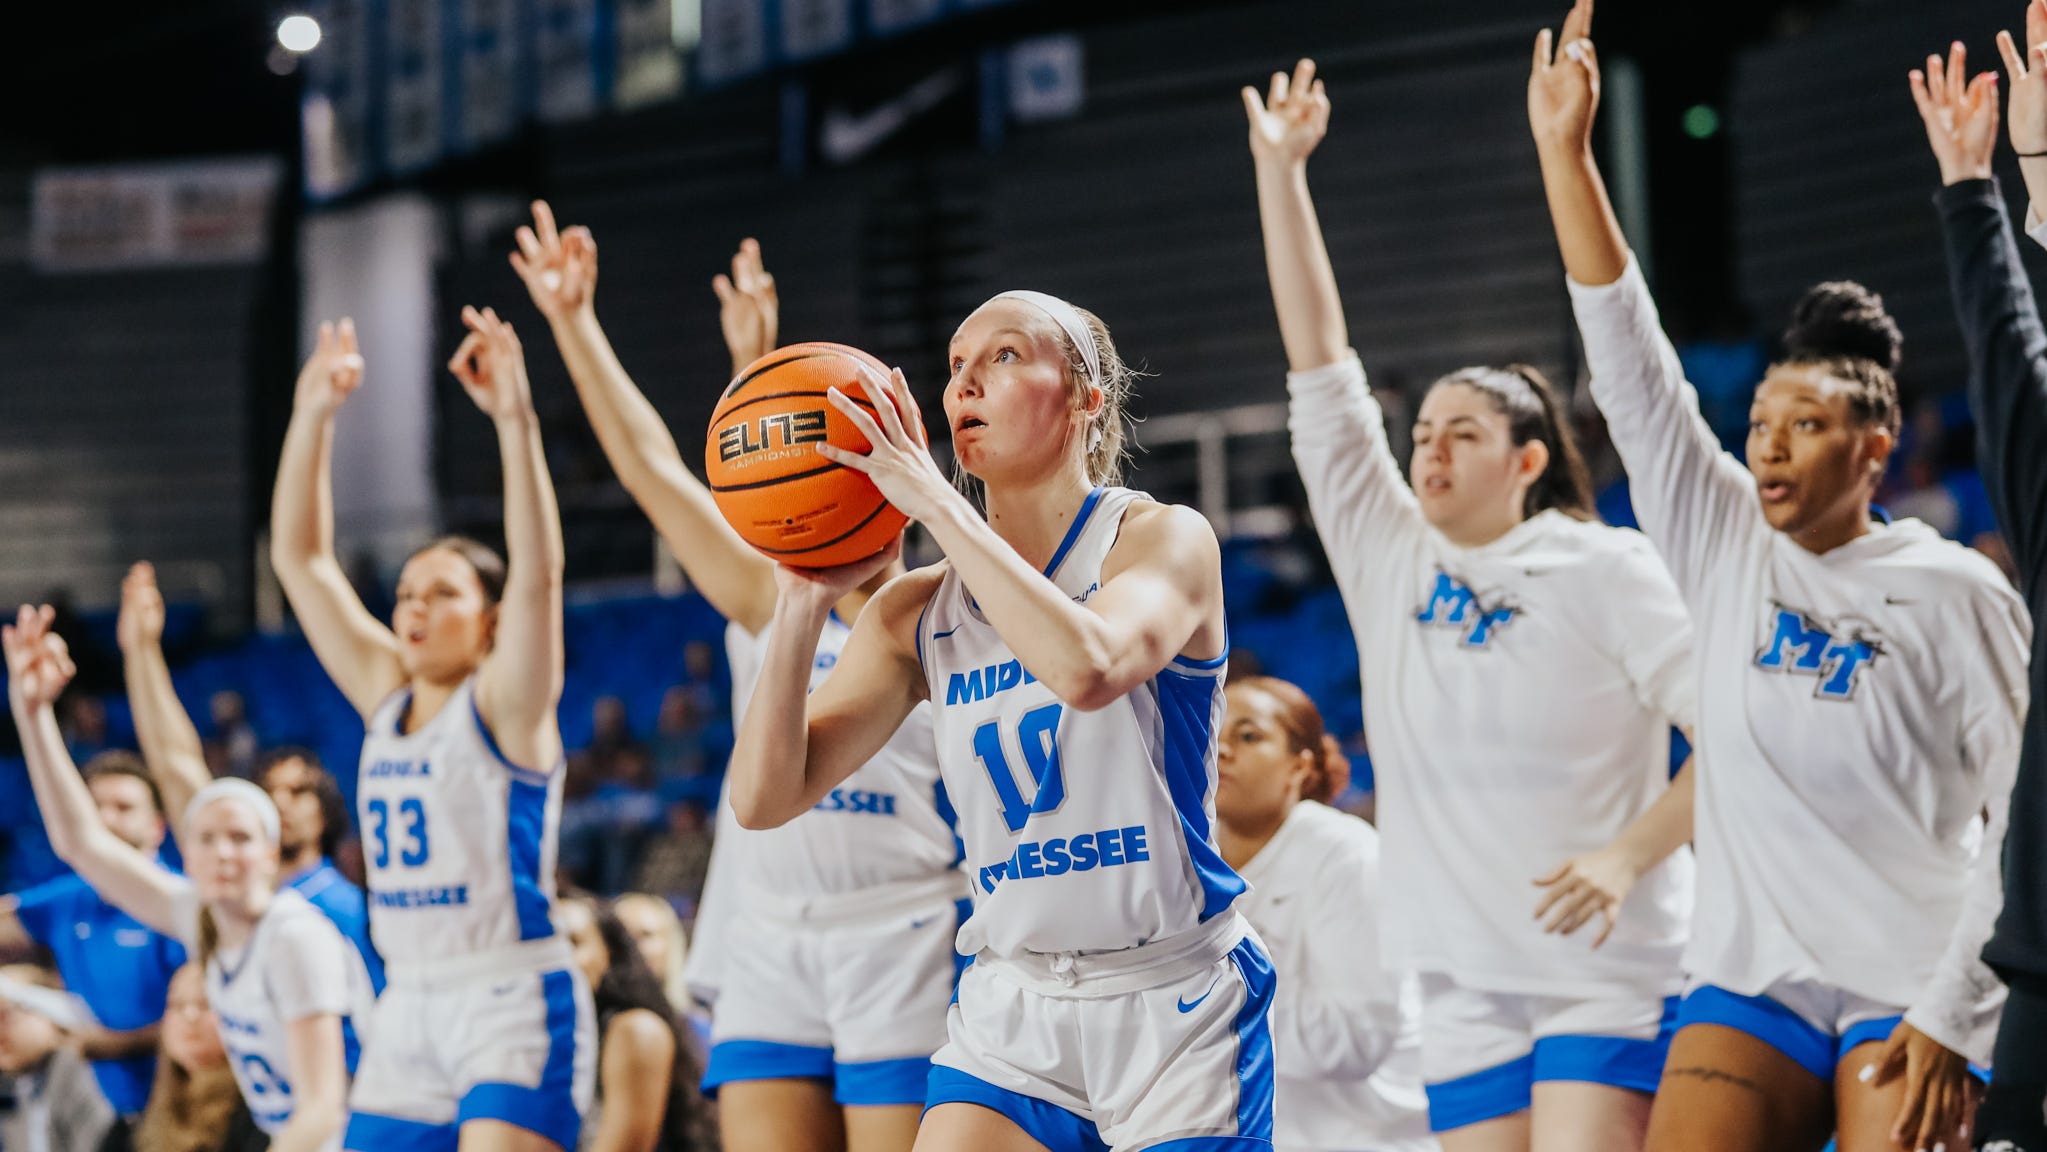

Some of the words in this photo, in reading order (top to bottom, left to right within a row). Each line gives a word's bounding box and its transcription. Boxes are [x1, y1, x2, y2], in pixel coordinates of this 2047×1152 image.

[719, 409, 828, 463] ELITE
[1413, 567, 1515, 650] MT
[946, 658, 1038, 706] MID
[1753, 602, 1877, 700] MT
[970, 700, 1069, 837] 10
[368, 797, 430, 869] 33
